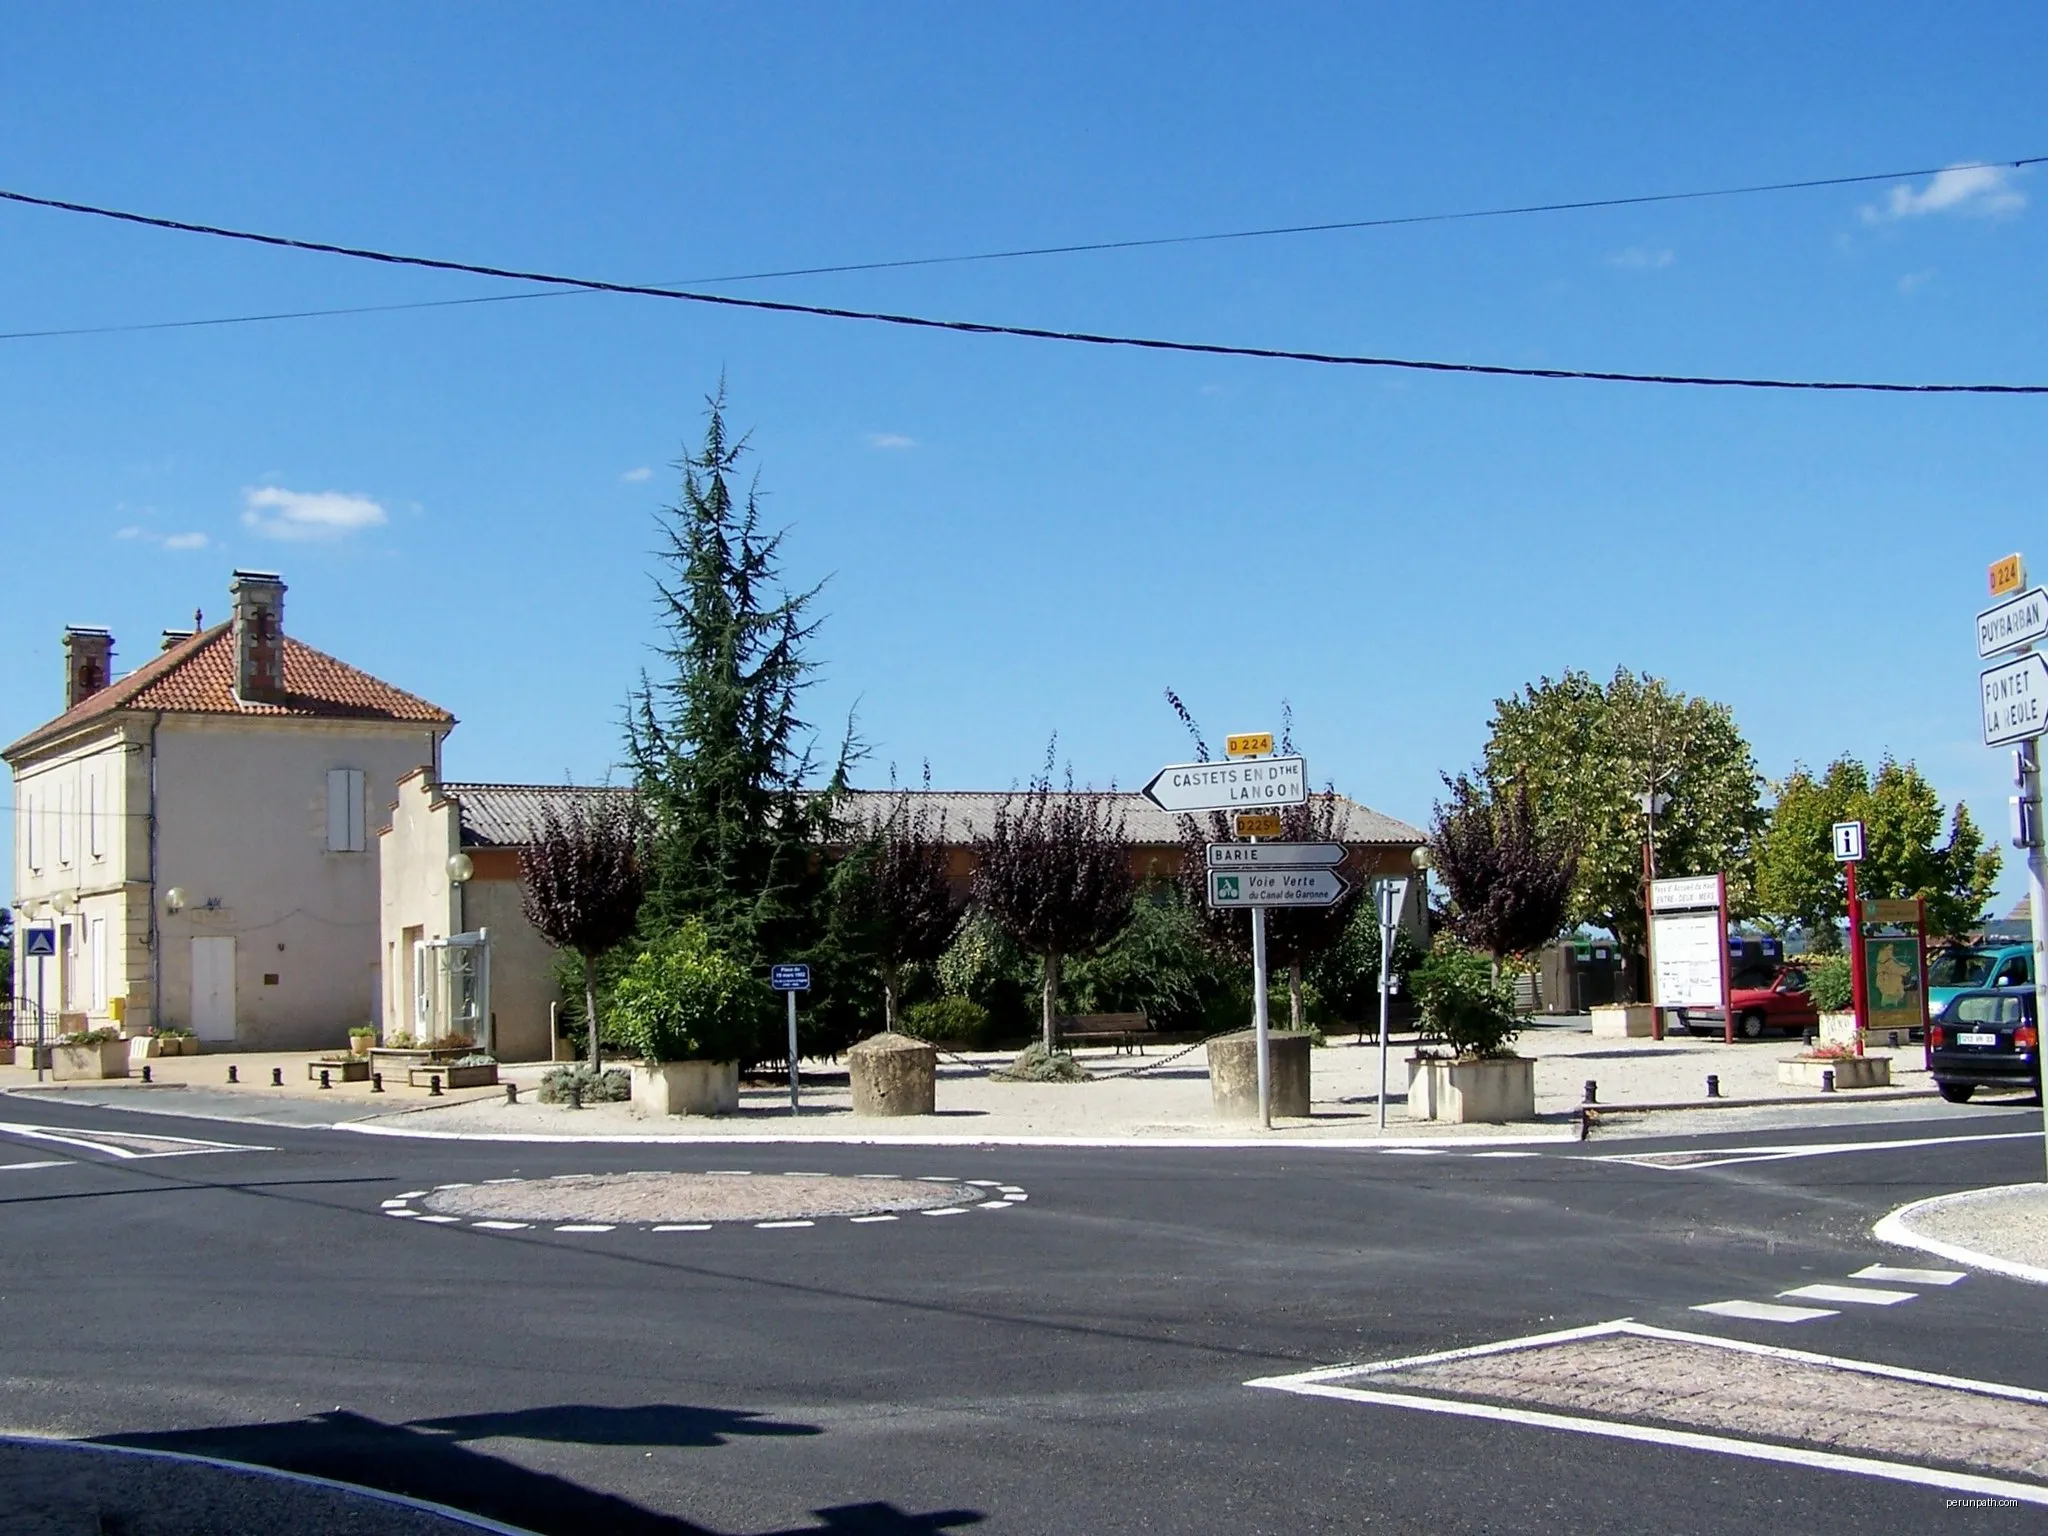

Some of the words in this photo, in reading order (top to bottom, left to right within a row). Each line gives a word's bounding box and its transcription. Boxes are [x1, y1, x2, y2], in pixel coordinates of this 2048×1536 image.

[1999, 563, 2016, 587] 224
[1981, 603, 2040, 645] PUYBARBAN
[1985, 670, 2029, 704] FONTET
[1987, 711, 2000, 733] LA
[2004, 698, 2038, 728] REOLE
[1230, 741, 1237, 751] D
[1242, 738, 1268, 750] 224
[1173, 770, 1237, 788] CASTETS
[1244, 768, 1263, 782] EN
[1230, 783, 1300, 800] LANGON
[1215, 850, 1258, 861] BARIE
[1249, 876, 1275, 887] Voie
[1283, 875, 1315, 887] Verte
[1249, 891, 1259, 900] du
[1260, 890, 1283, 899] Canal
[1284, 890, 1294, 899] de
[1295, 889, 1329, 899] Garonne
